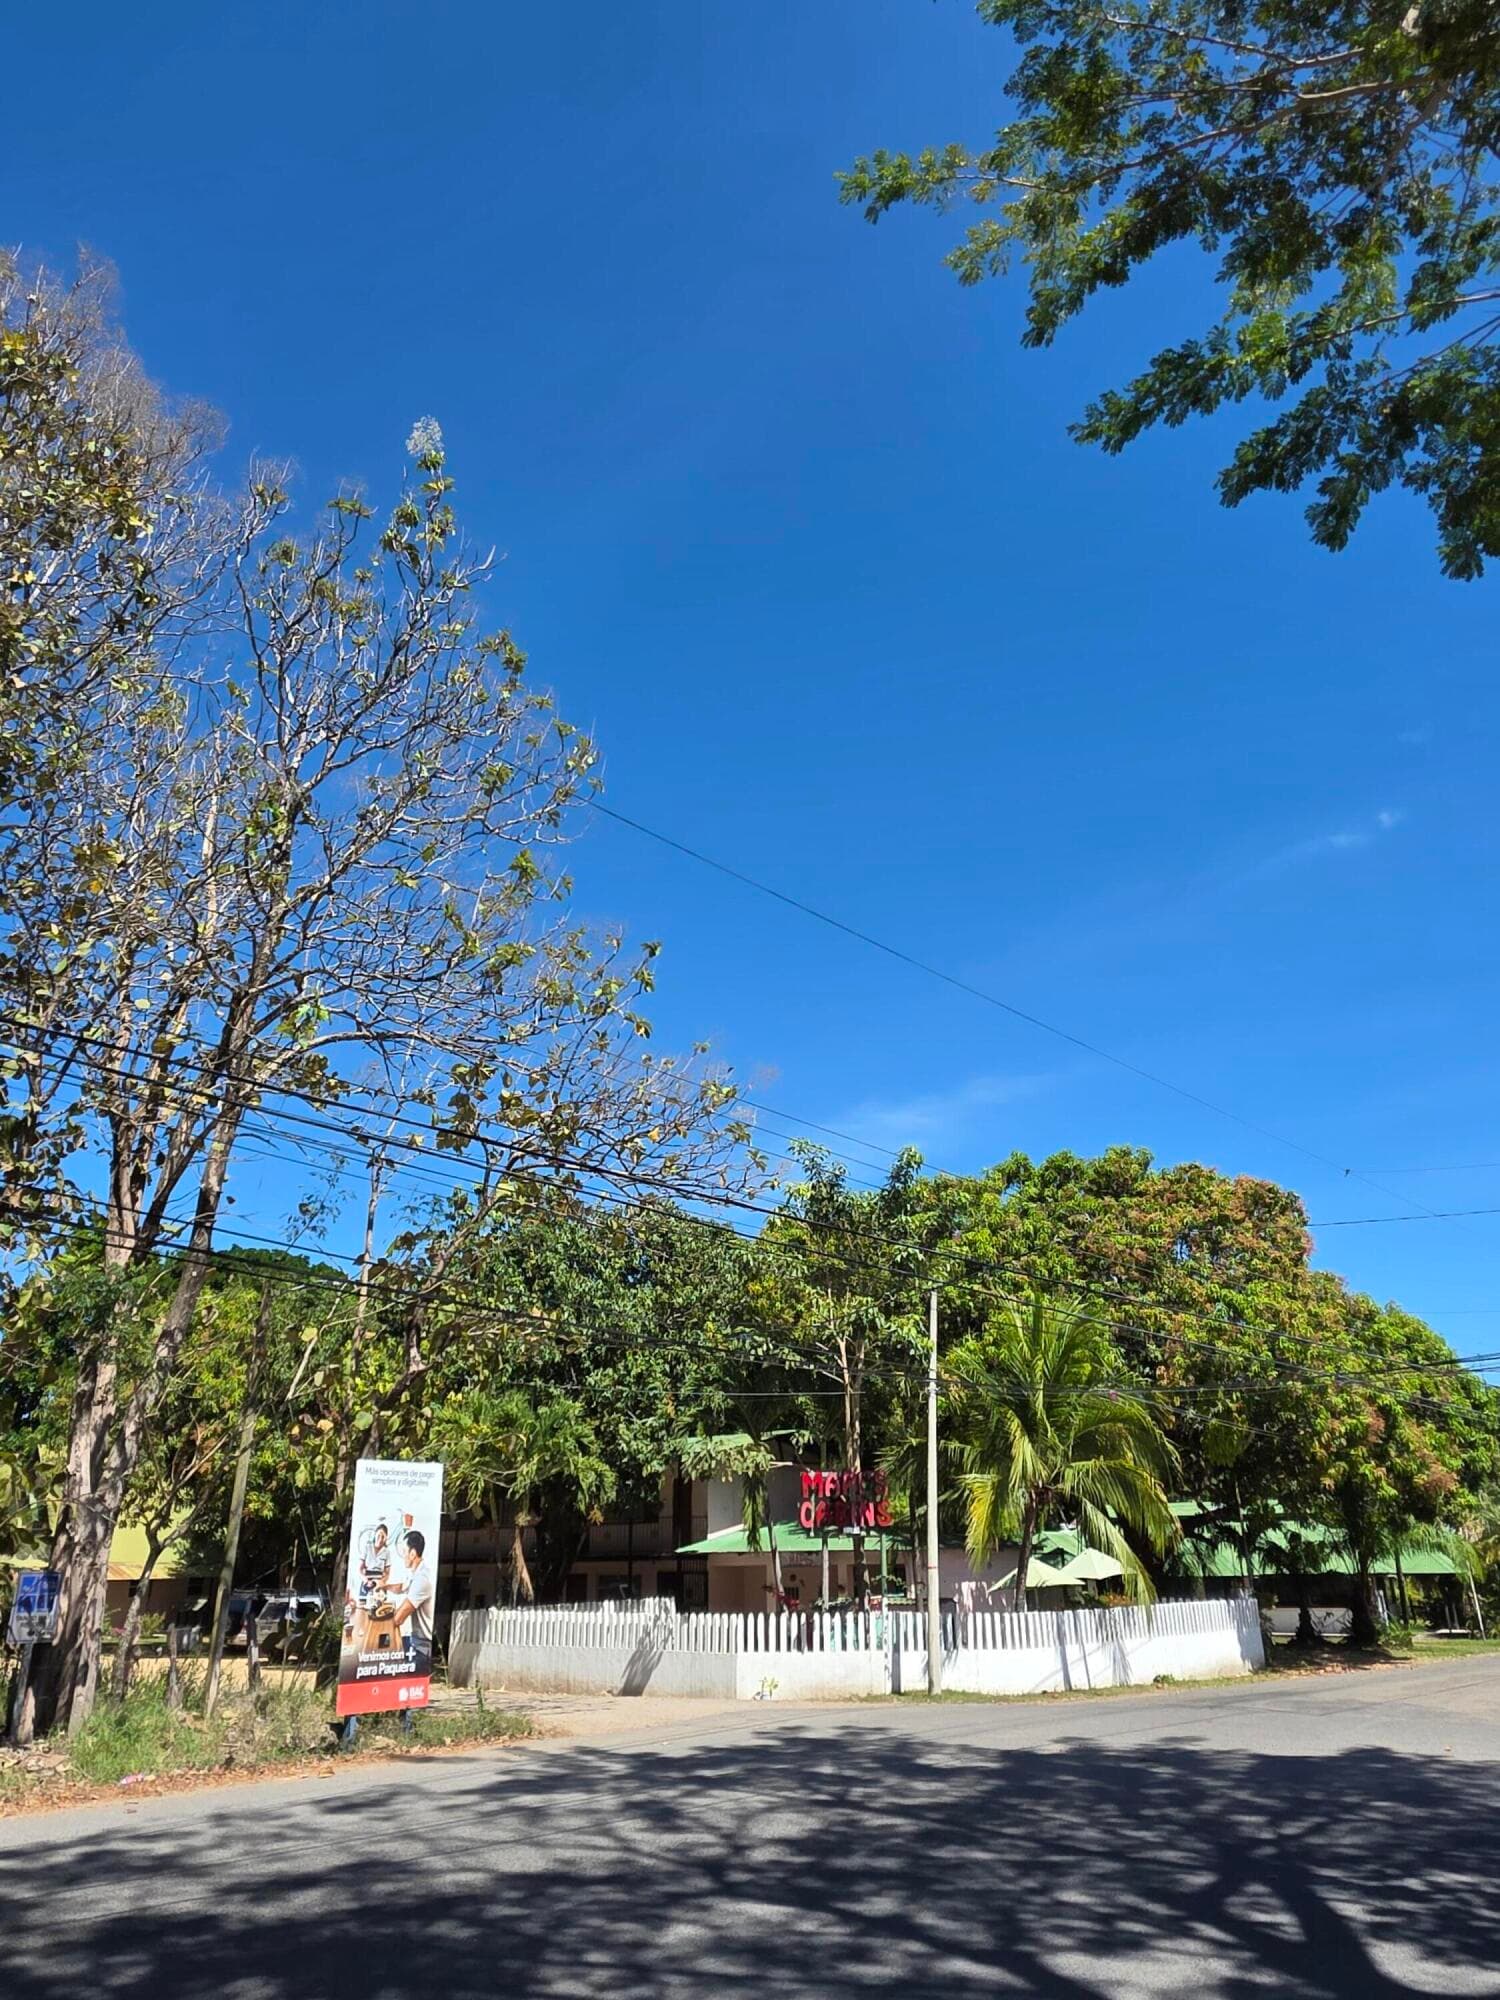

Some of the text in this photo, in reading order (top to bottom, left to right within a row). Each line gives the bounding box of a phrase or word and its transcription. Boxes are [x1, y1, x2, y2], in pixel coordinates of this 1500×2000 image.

[380, 1468, 409, 1478] opciones
[410, 1469, 418, 1478] de
[419, 1471, 436, 1480] pago
[358, 1651, 390, 1662] Venimos
[391, 1651, 405, 1660] con
[356, 1662, 416, 1679] para Paquera
